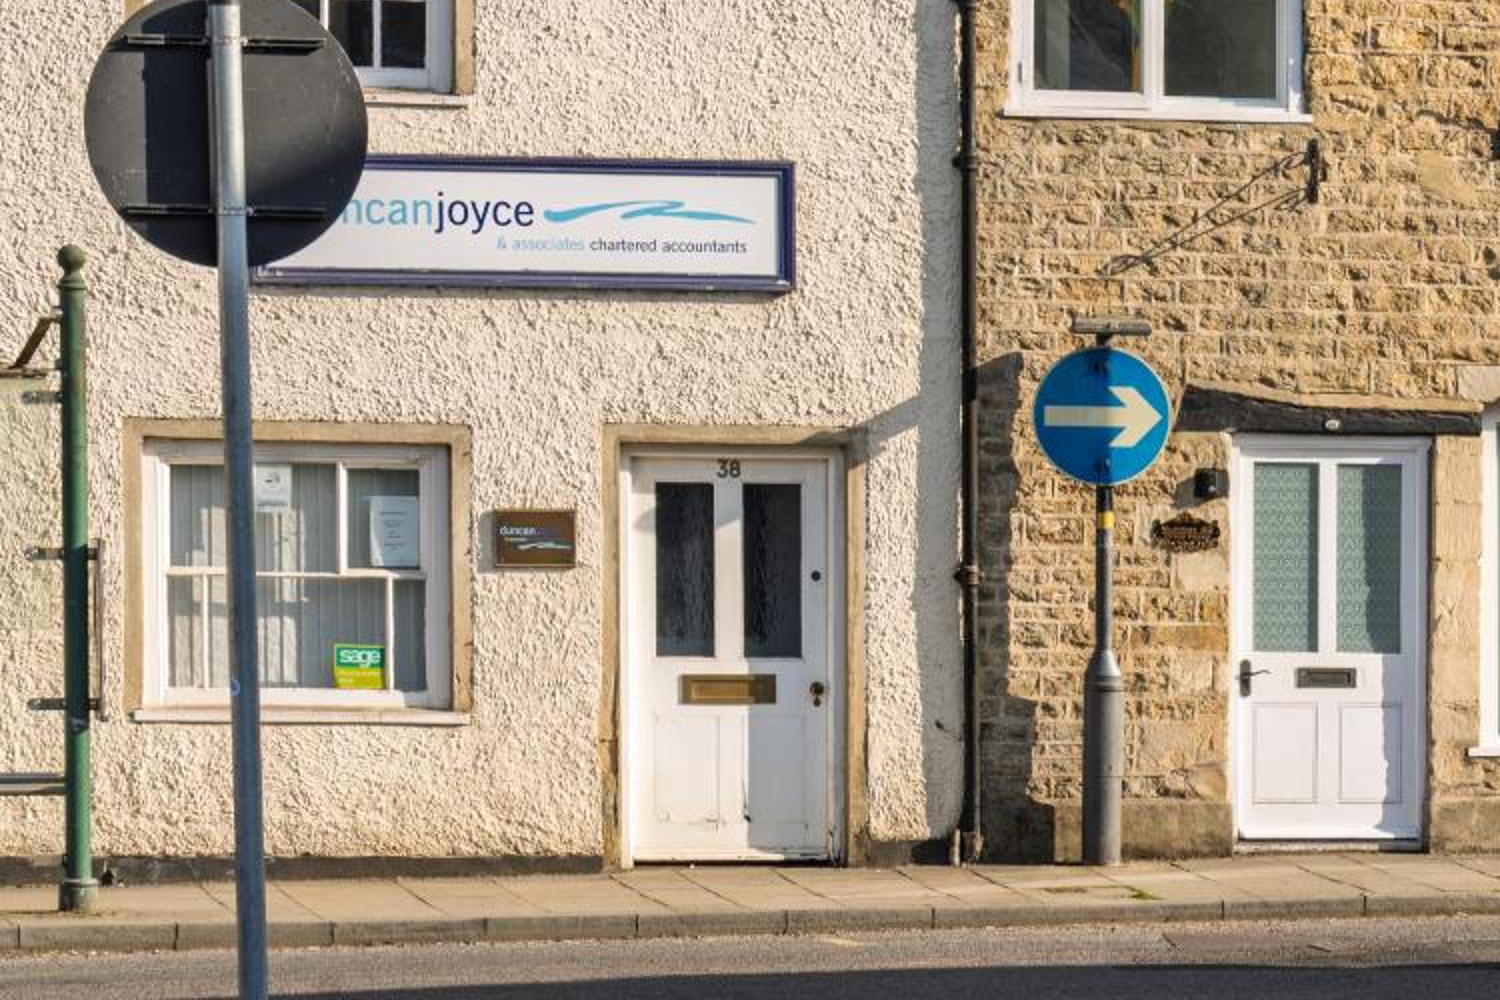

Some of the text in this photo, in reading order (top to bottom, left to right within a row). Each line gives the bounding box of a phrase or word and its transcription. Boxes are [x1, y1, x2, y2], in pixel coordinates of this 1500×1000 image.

[341, 191, 535, 235] ncanjoyce
[512, 236, 584, 251] associates
[590, 237, 657, 252] chartered
[661, 240, 748, 253] accountants
[717, 457, 741, 478] 38
[339, 649, 381, 668] sage
